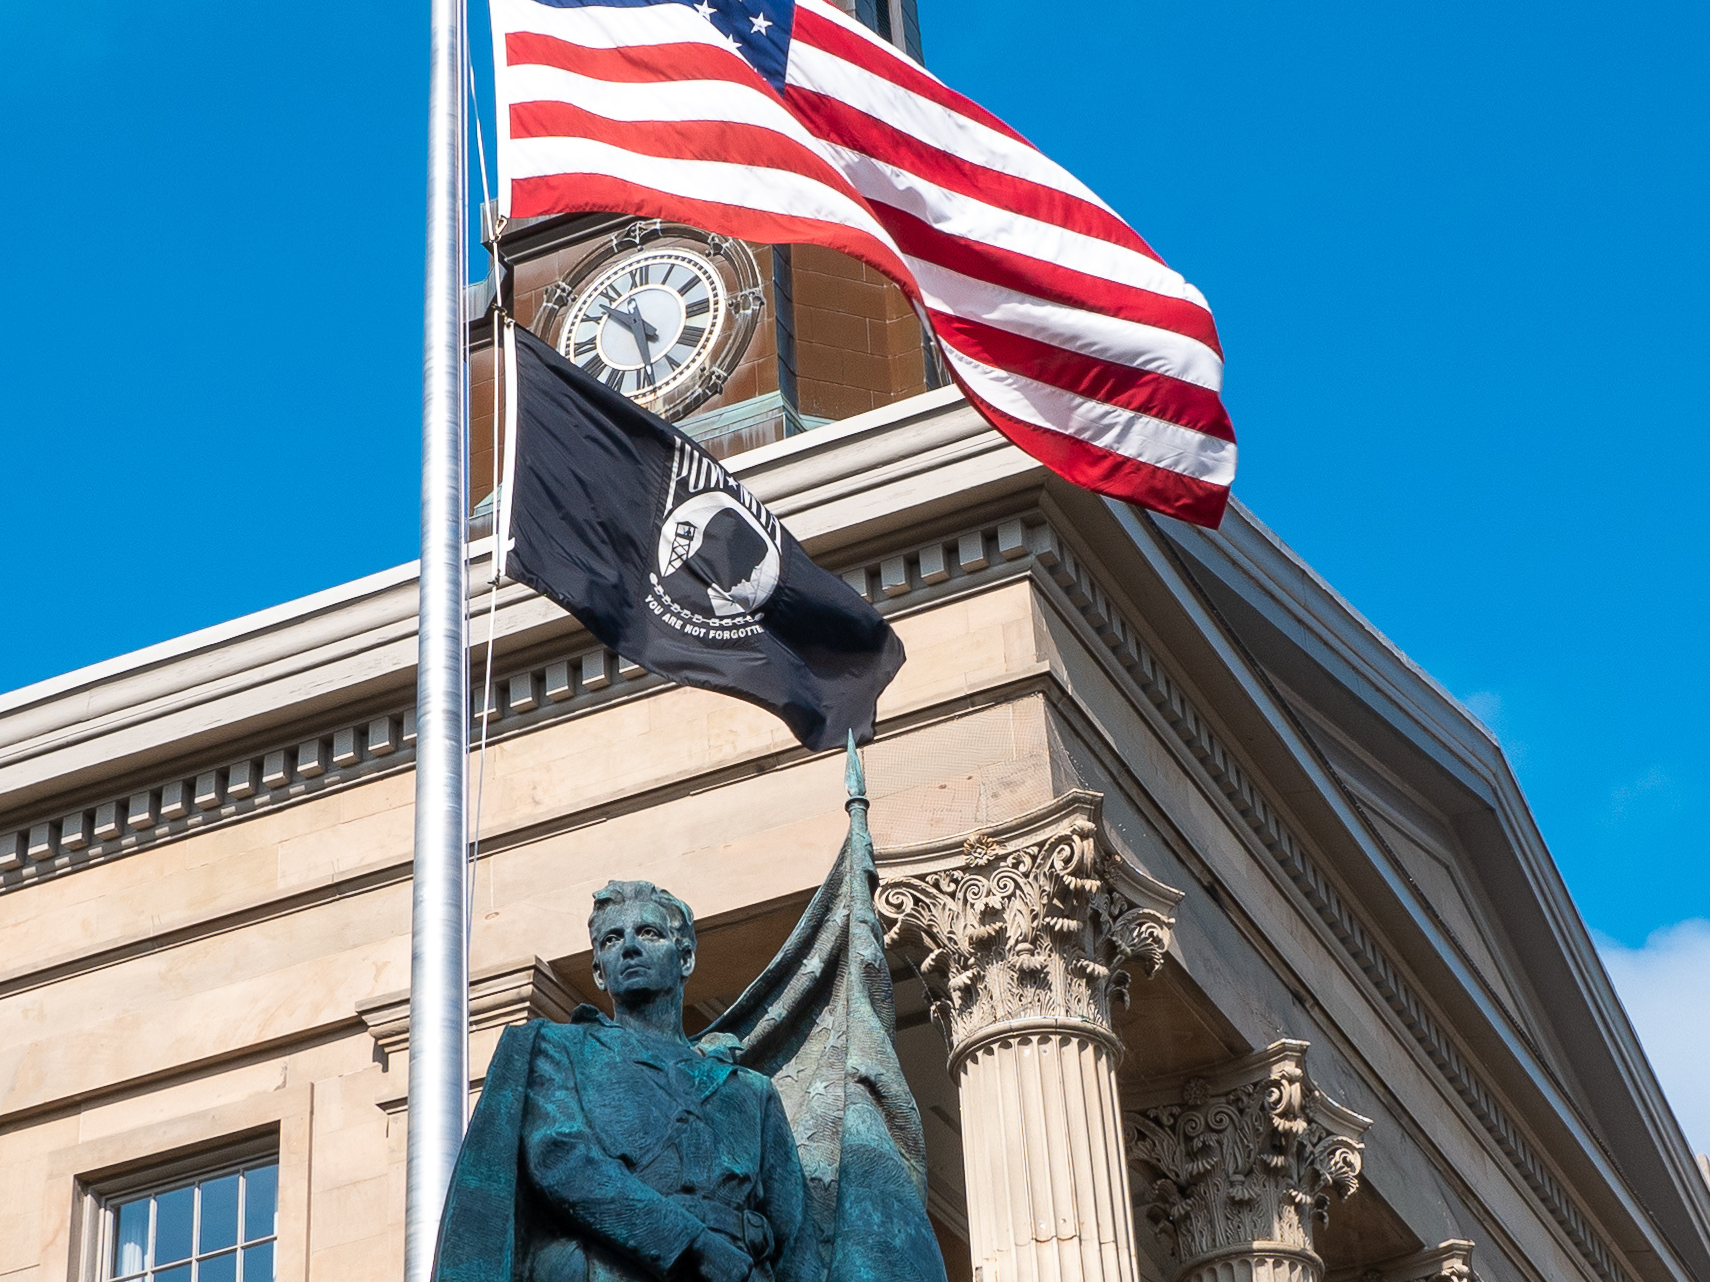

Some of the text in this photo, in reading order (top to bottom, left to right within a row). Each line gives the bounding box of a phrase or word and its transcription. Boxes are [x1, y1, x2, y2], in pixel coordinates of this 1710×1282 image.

[662, 435, 782, 557] POW MIA
[645, 594, 765, 641] YOU ARE NOT FORGOTTE
